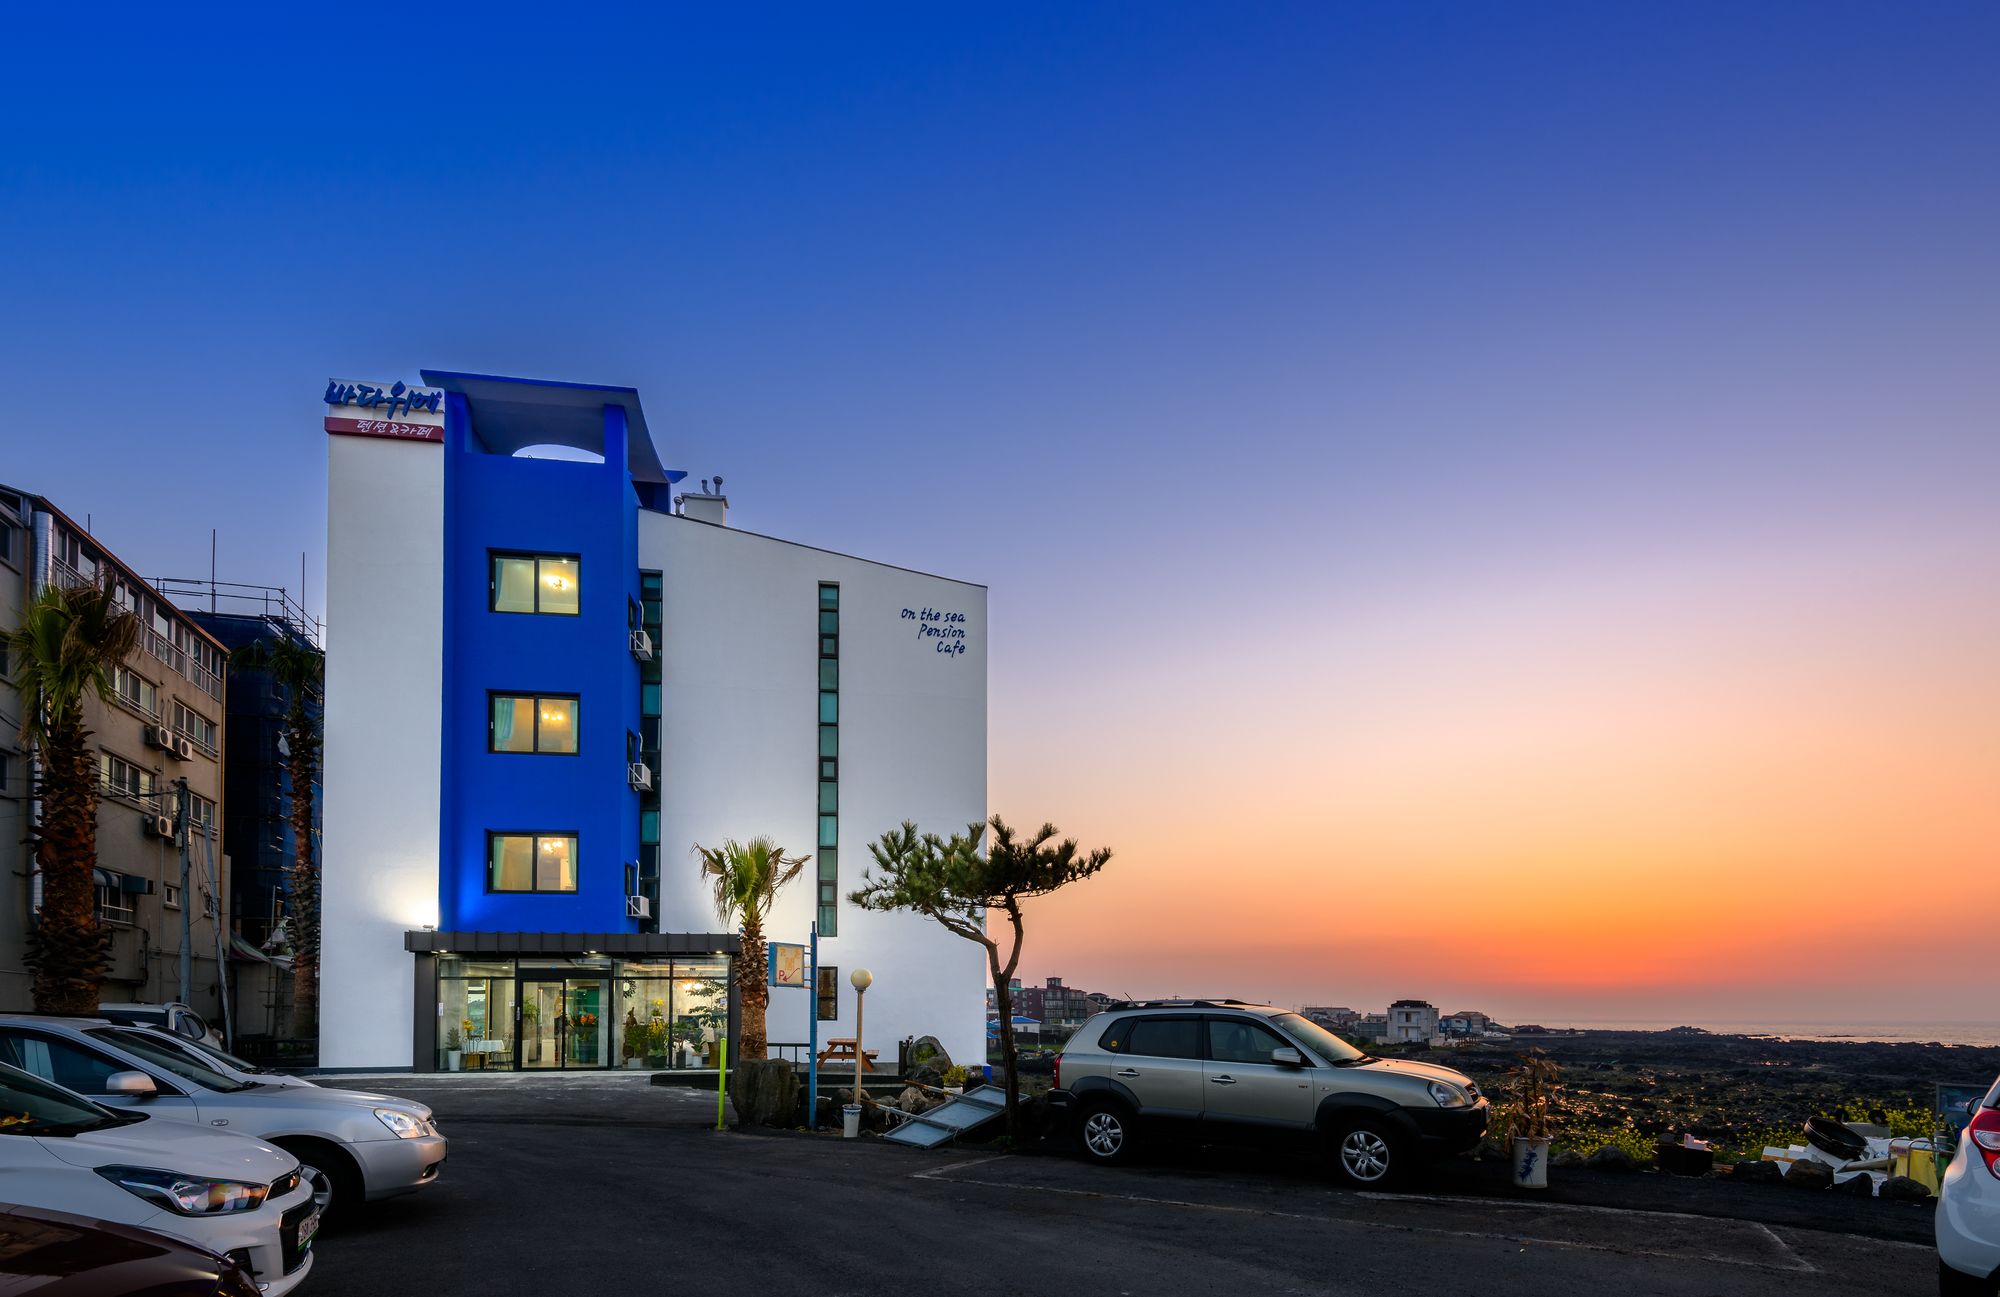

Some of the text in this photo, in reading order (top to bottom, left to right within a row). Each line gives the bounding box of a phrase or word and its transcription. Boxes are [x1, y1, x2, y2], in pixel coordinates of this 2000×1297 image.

[324, 380, 443, 420] 바다위에
[920, 607, 941, 621] the
[944, 612, 966, 623] sea
[778, 970, 785, 981] P
